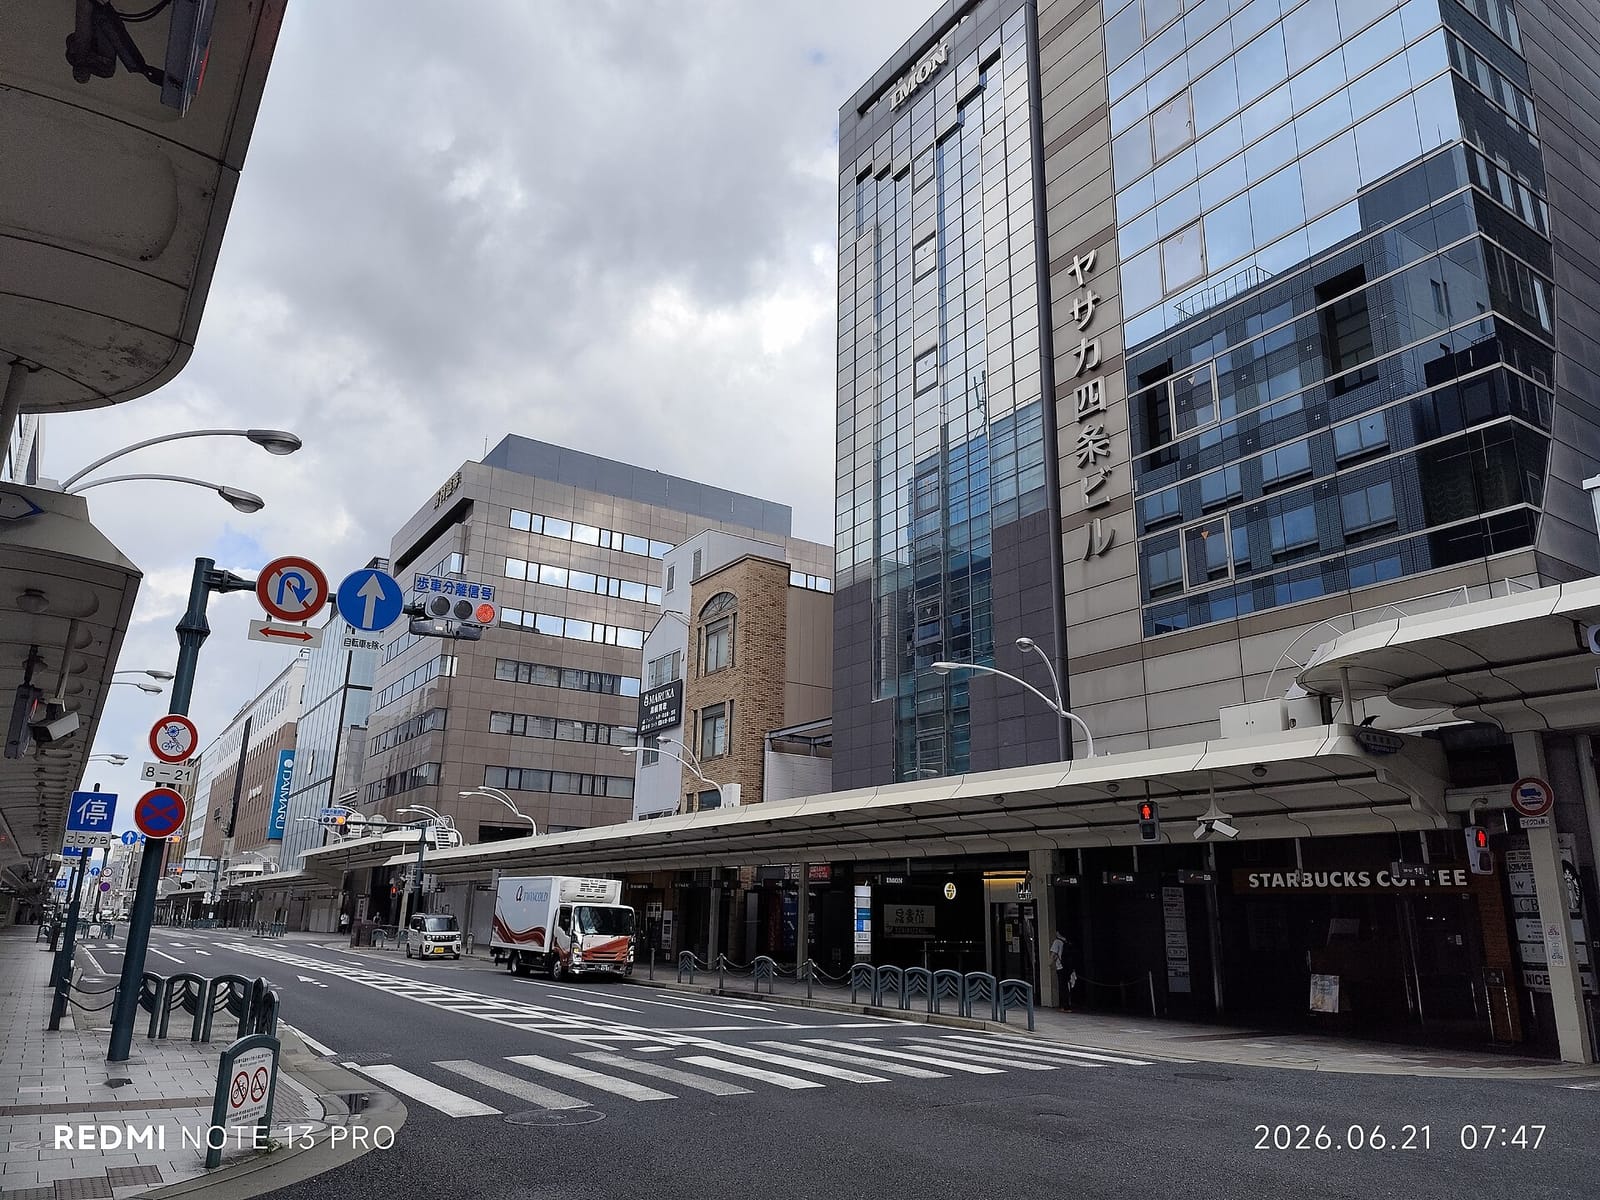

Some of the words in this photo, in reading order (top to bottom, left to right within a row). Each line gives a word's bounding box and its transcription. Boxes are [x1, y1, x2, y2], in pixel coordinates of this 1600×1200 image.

[889, 43, 949, 112] EMON
[1066, 248, 1115, 561] ヤサカ四条ビル
[416, 576, 493, 600] 歩車分離信号
[343, 637, 385, 651] 自転車を除く
[77, 798, 108, 826] 停
[275, 769, 292, 830] DAIMARU
[66, 835, 109, 845] ここから
[1248, 872, 1371, 888] STARBUCKS
